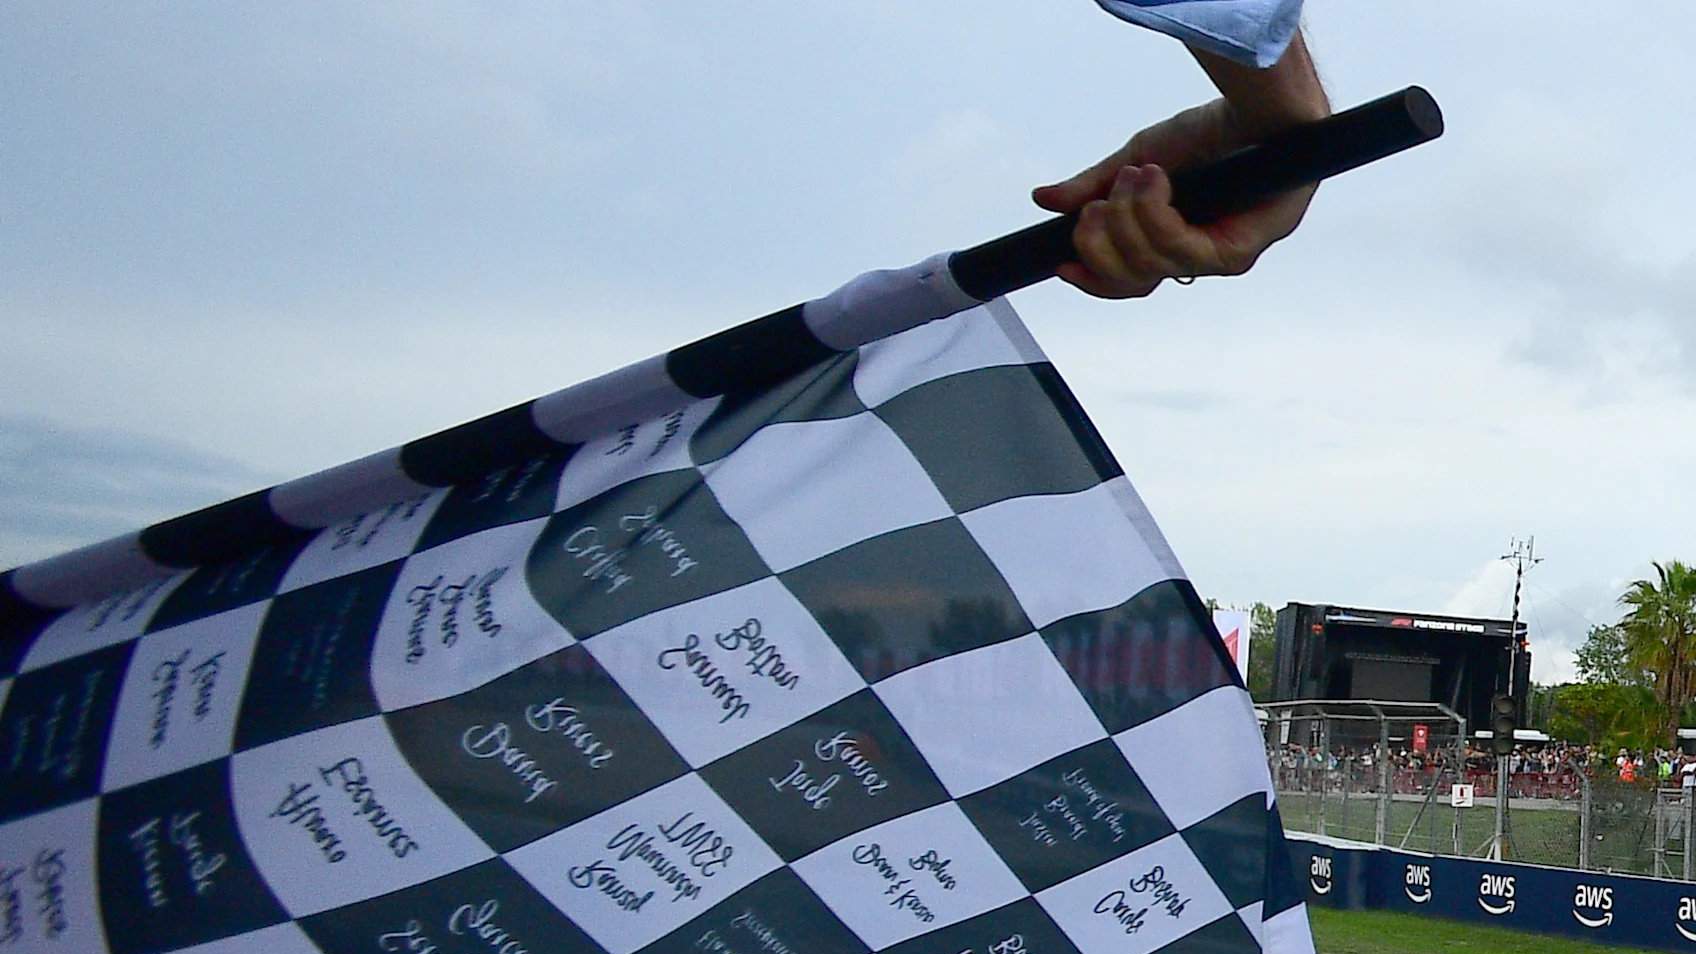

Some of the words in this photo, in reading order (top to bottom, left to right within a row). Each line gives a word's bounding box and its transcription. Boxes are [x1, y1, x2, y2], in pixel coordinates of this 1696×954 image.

[1311, 855, 1332, 879] aws
[1407, 863, 1430, 887] aws
[1480, 875, 1515, 899] aws
[1574, 885, 1613, 910] aws
